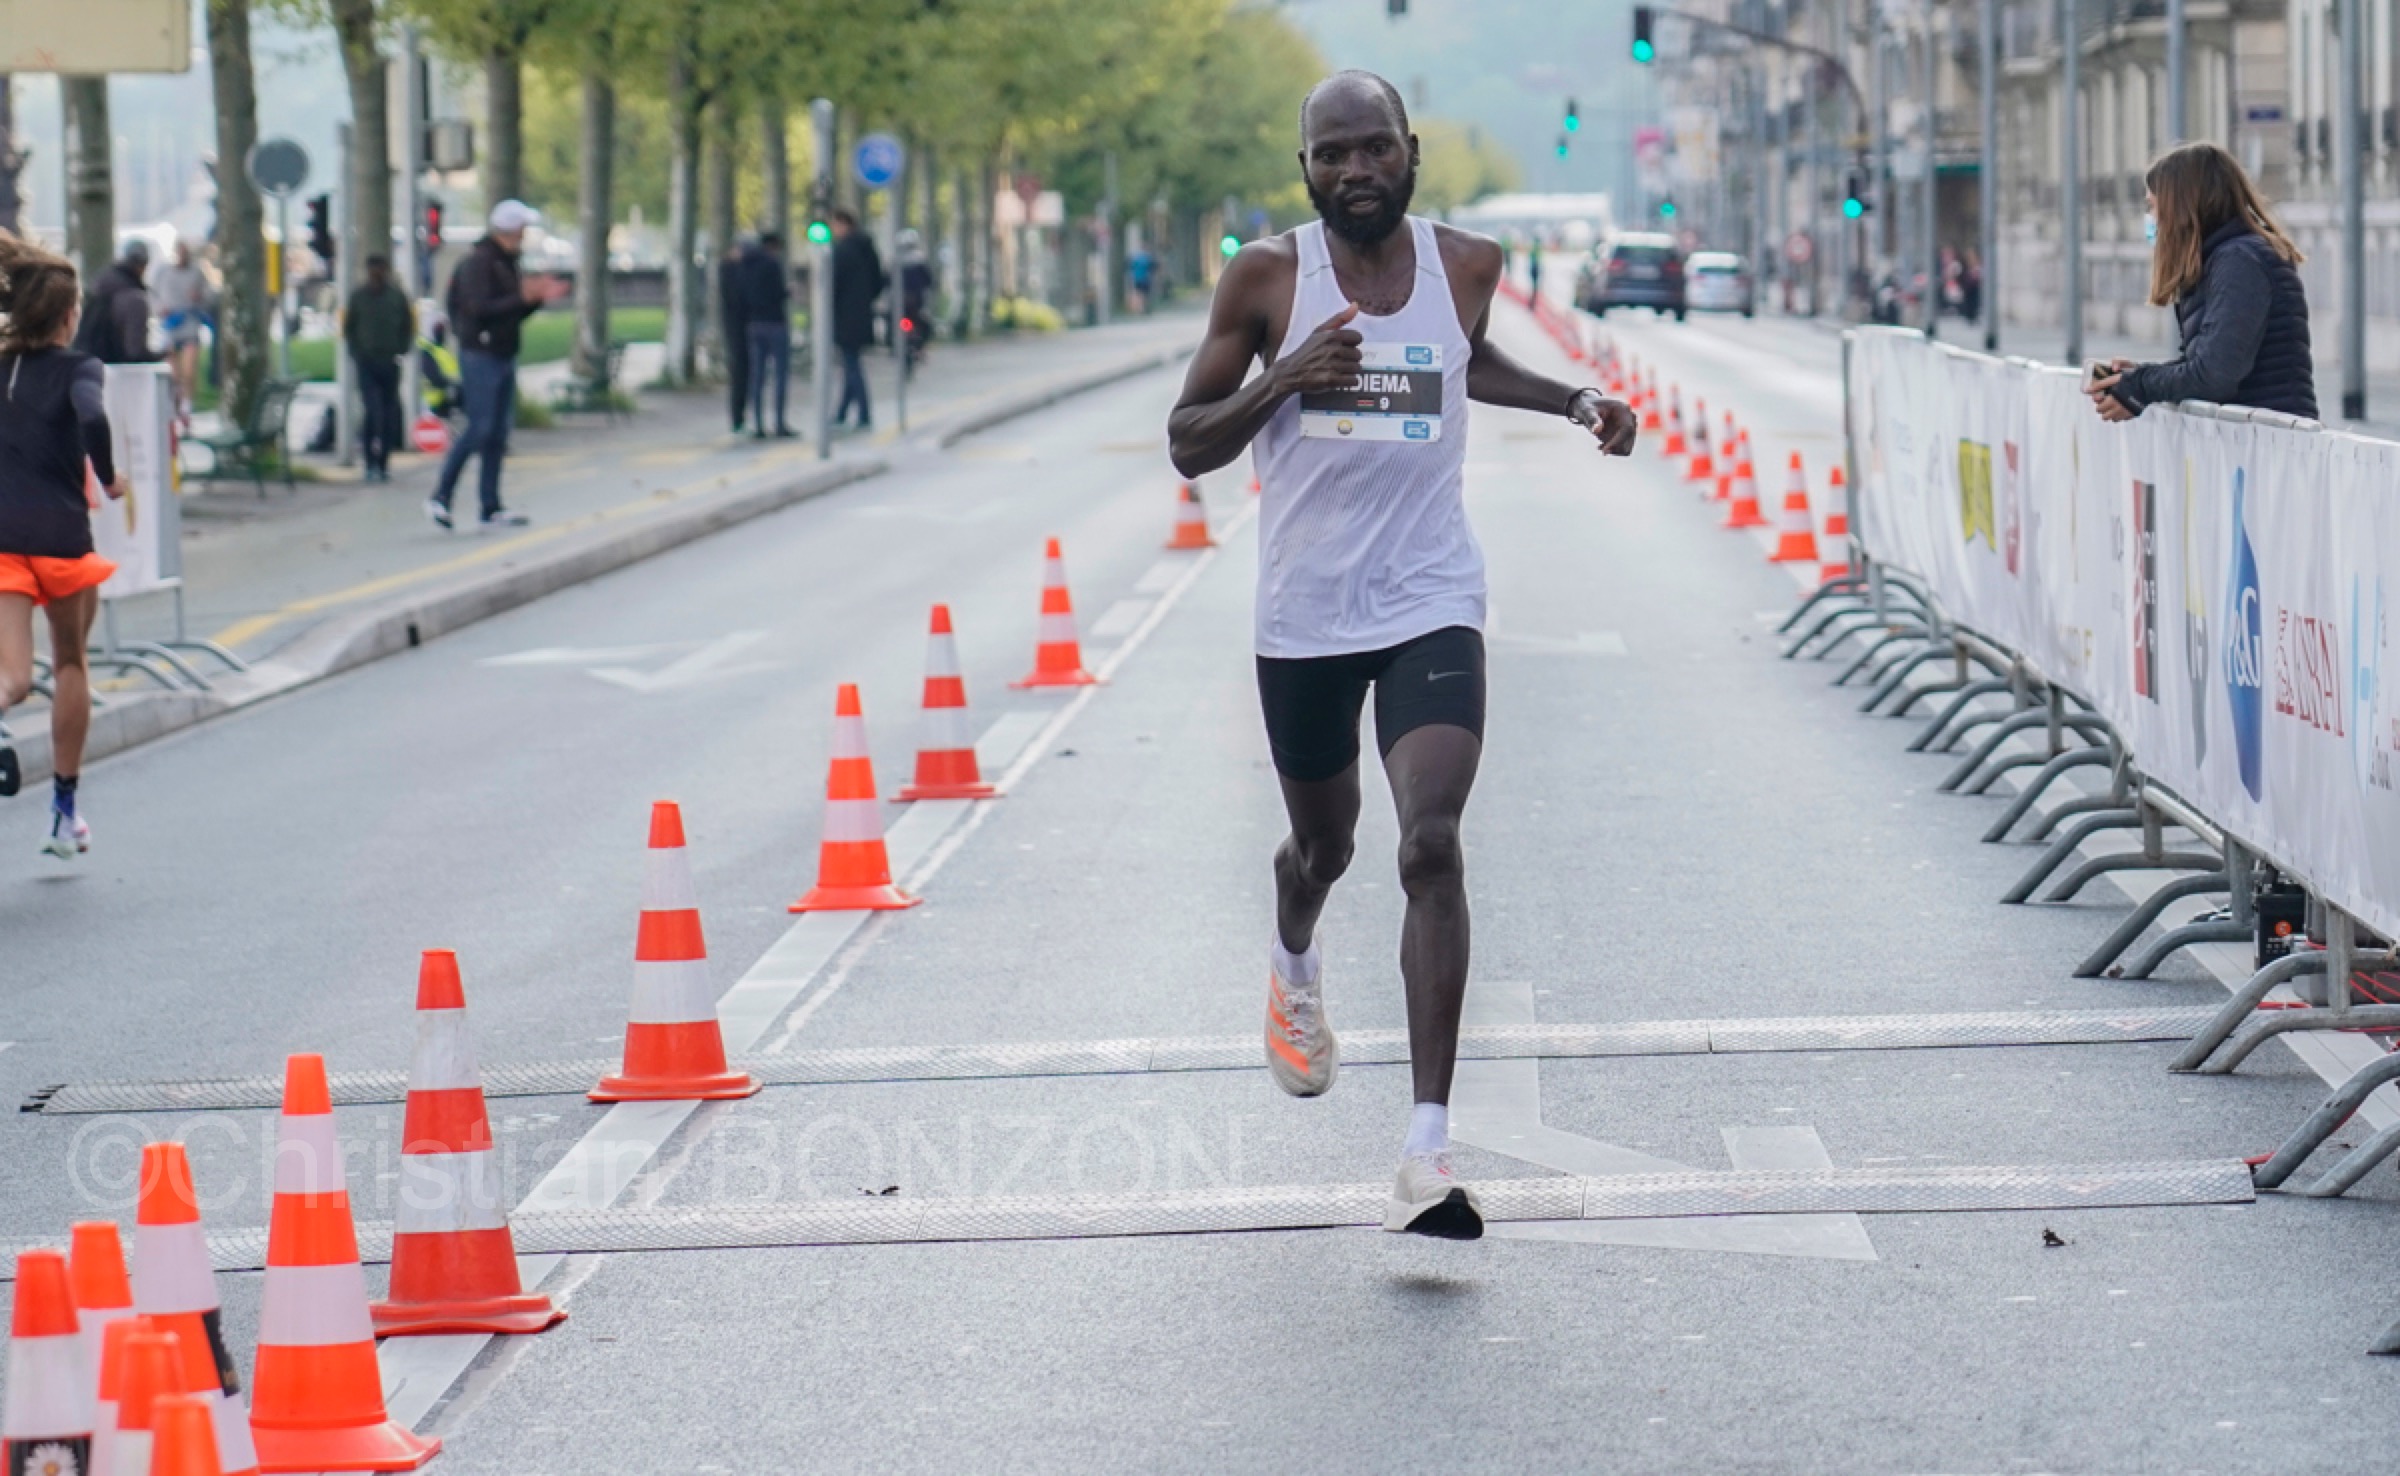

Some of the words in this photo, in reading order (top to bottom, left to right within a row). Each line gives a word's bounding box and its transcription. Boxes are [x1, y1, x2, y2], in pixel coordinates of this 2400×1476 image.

[1335, 374, 1411, 392] DIEMA
[1380, 396, 1390, 410] 9
[2226, 586, 2261, 688] P&G
